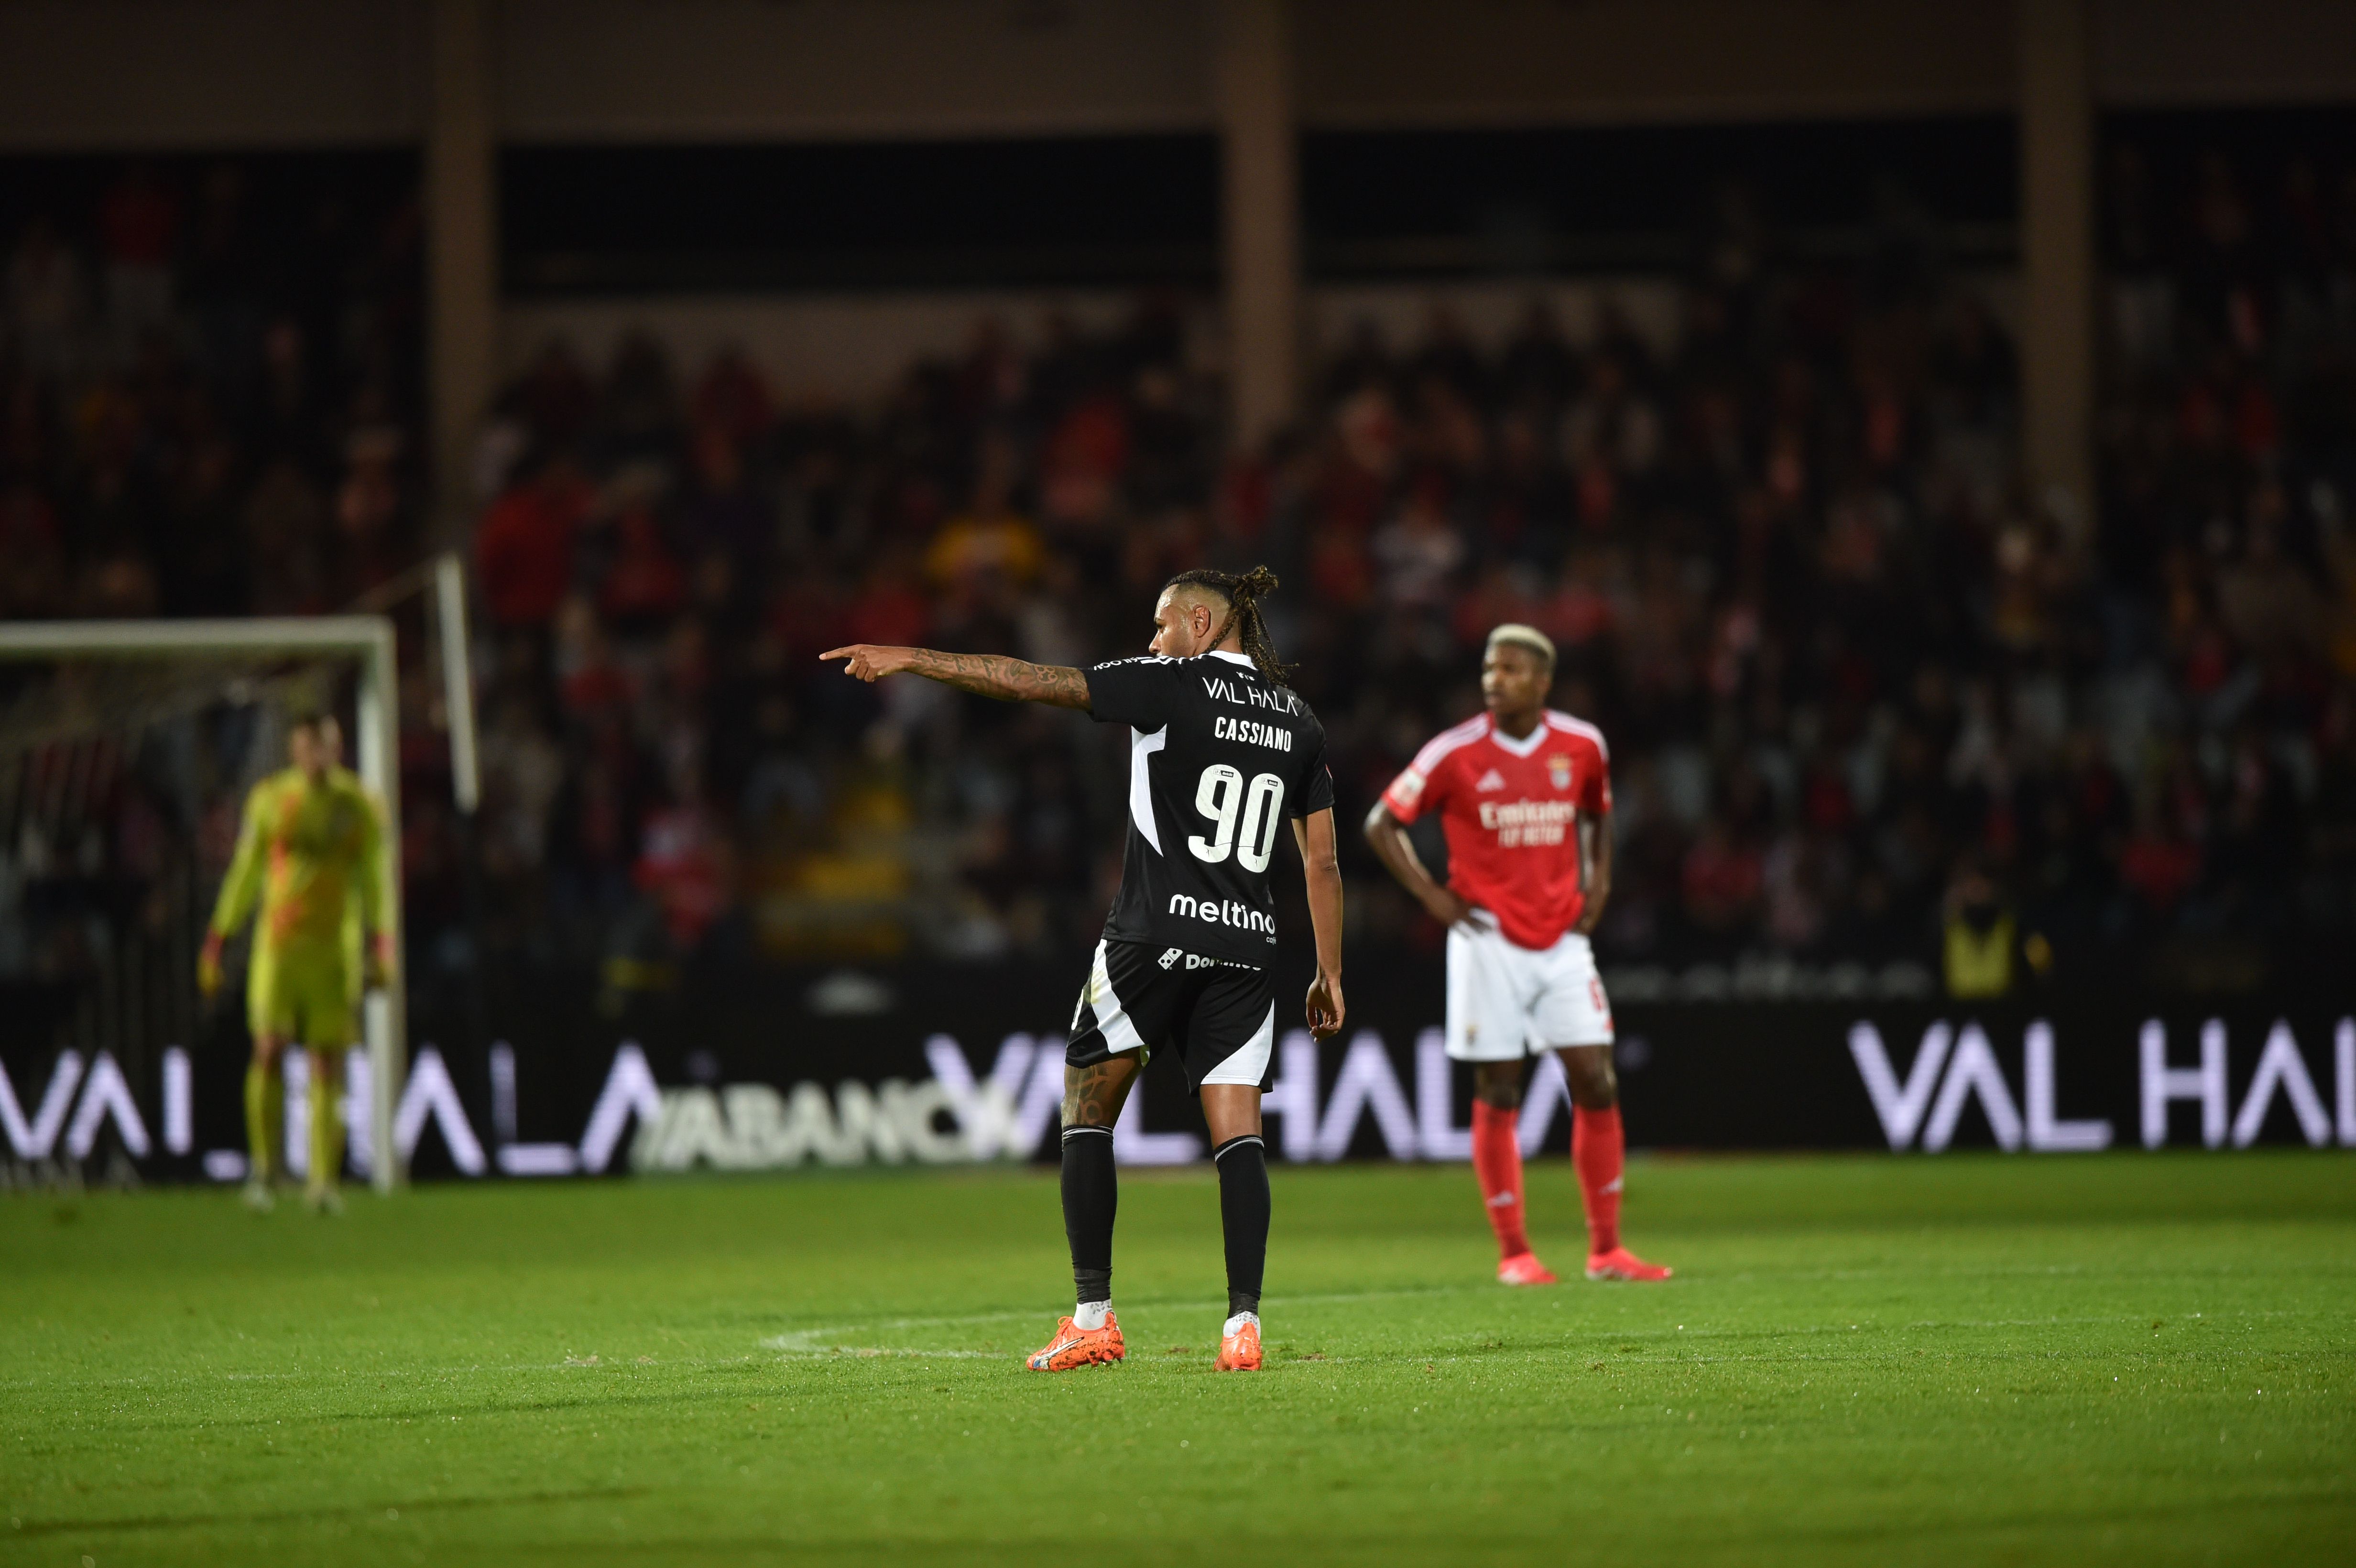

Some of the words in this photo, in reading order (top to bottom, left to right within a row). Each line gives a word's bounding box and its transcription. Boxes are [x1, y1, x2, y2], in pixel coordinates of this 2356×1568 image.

[1202, 677, 1245, 704] VAL
[1214, 716, 1291, 752] CASSIANO
[1188, 764, 1285, 873] 90
[1169, 894, 1275, 935] meltino
[1846, 1018, 2112, 1151] VAL
